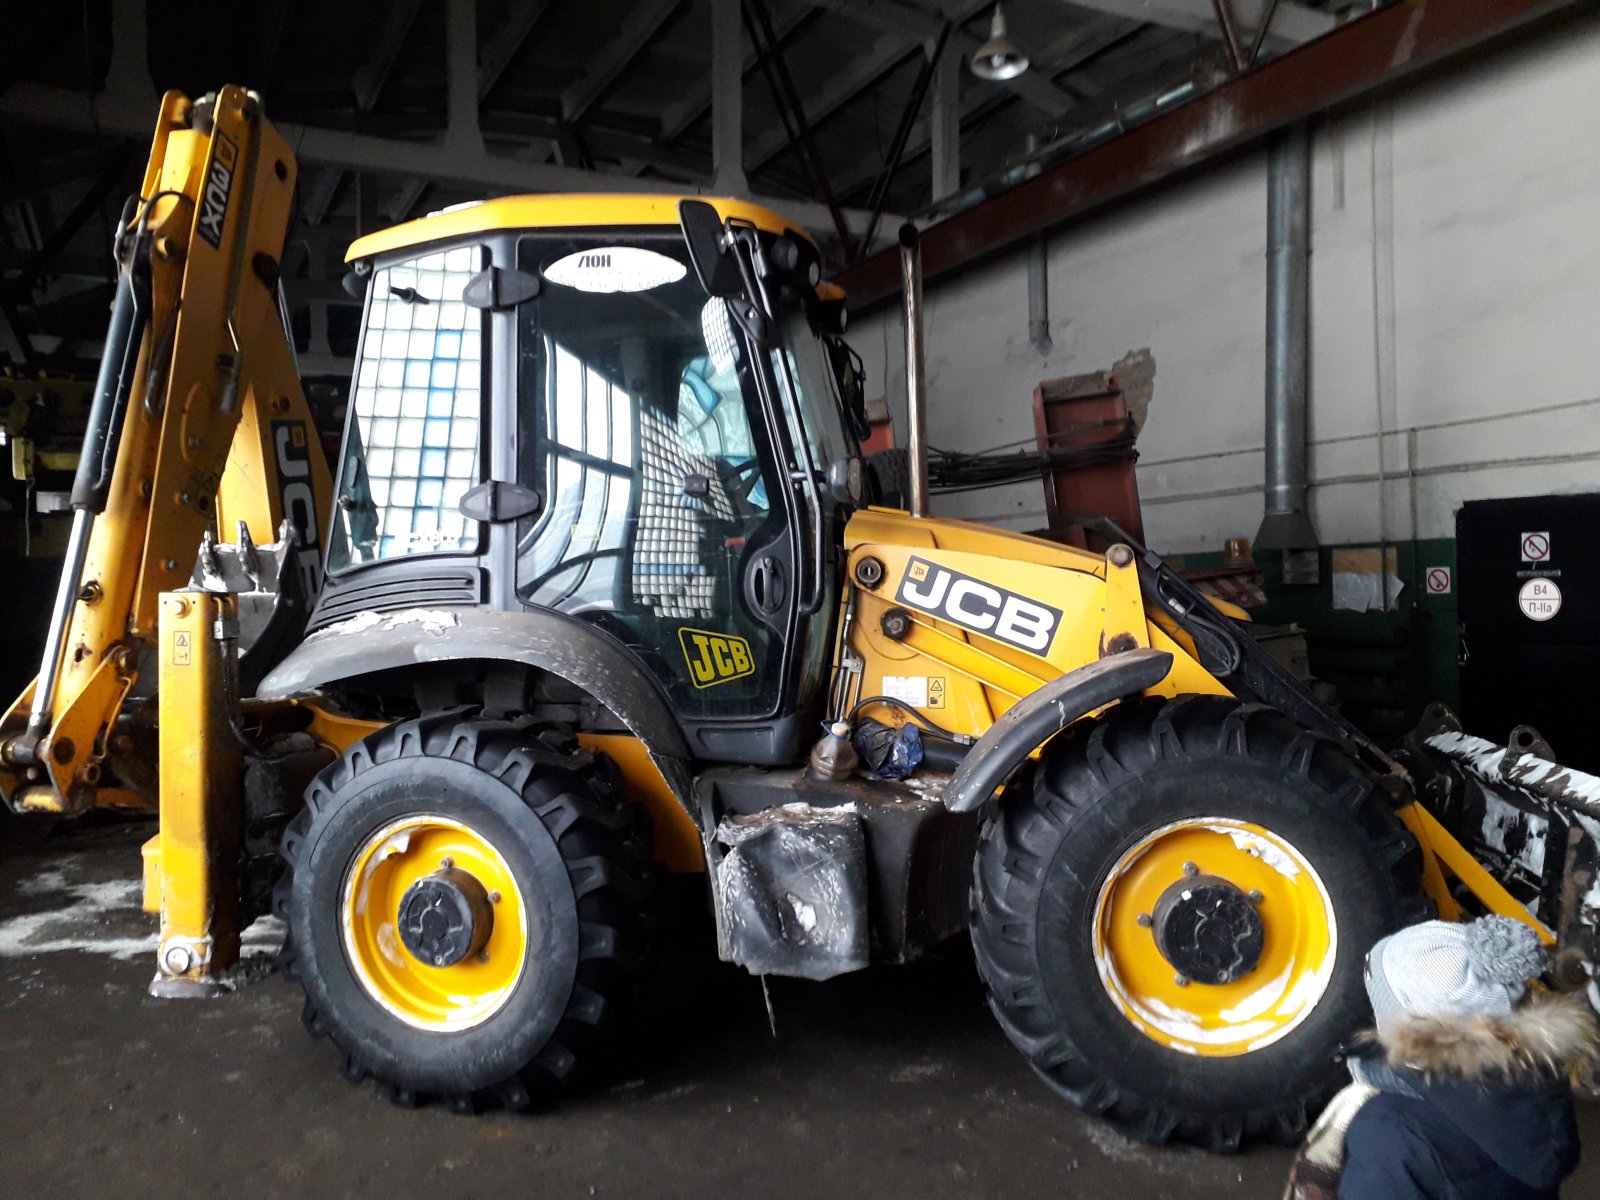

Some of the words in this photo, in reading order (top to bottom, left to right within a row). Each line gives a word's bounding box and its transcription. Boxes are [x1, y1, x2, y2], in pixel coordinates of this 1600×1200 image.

[902, 569, 1055, 650] JCB
[1534, 585, 1547, 595] В4
[692, 634, 750, 682] JCB
